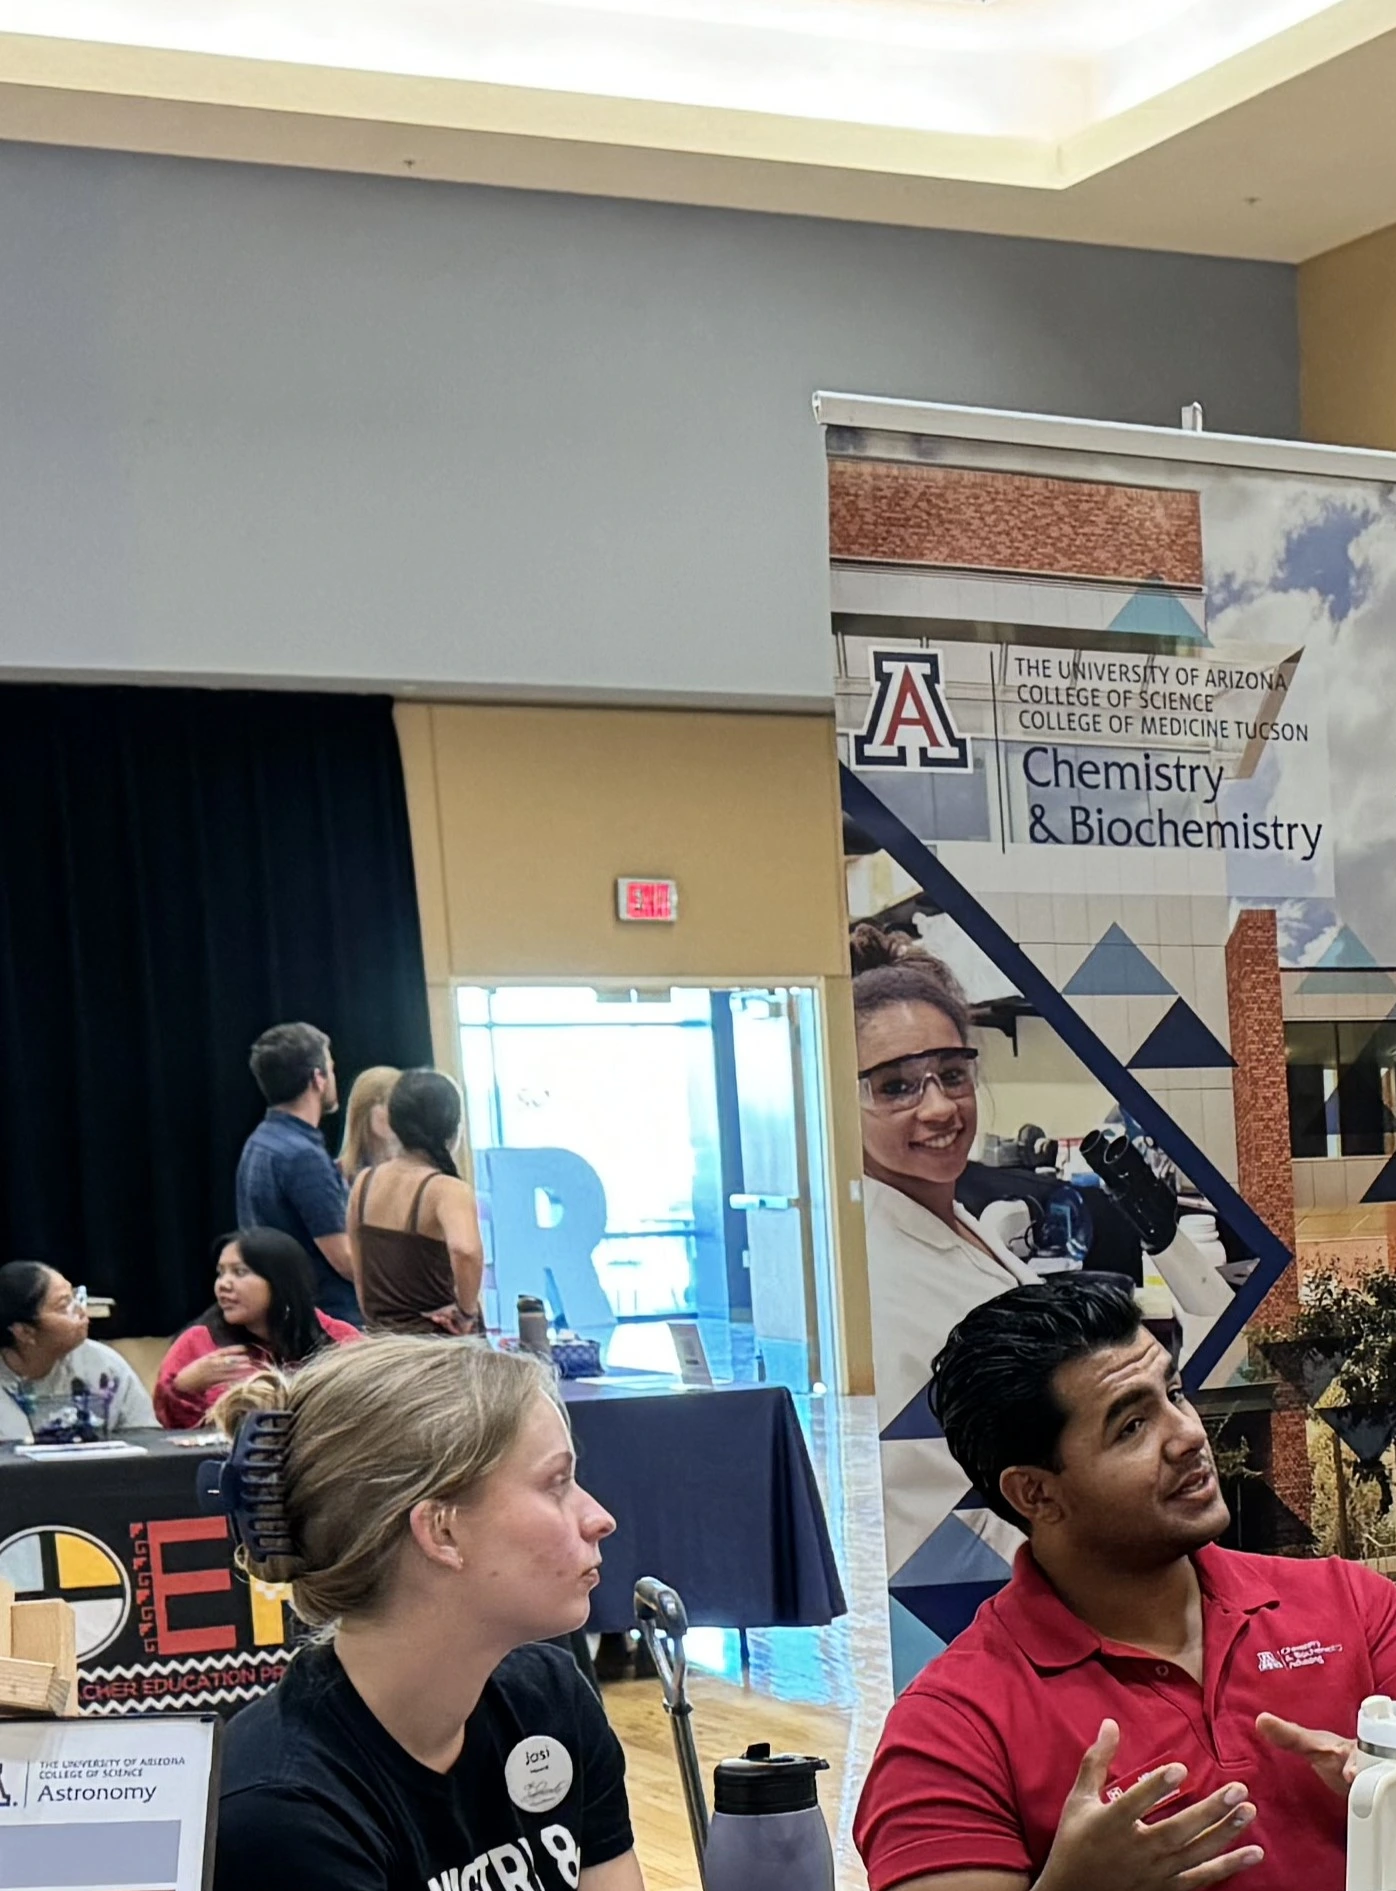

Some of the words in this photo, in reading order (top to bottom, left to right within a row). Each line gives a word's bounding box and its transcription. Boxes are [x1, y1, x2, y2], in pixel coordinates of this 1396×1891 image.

[1014, 657, 1052, 679] THE
[1057, 659, 1172, 686] UNIVERSITY
[1175, 666, 1200, 687] OF
[1204, 668, 1287, 692] ARIZONA
[1017, 683, 1101, 708] COLLEGE
[1106, 687, 1133, 708] OF
[1138, 690, 1214, 713] SCIENCE
[1018, 709, 1102, 734] COLLEGE
[1108, 713, 1134, 735] OF
[1140, 715, 1229, 740] MEDICINE
[1235, 720, 1309, 742] TUCSON
[1021, 745, 1226, 804] Chemistry
[1028, 804, 1067, 844] &
[1070, 804, 1324, 861] Biochemistry
[143, 1668, 256, 1695] EDUCATION
[38, 1785, 157, 1804] Astronomy
